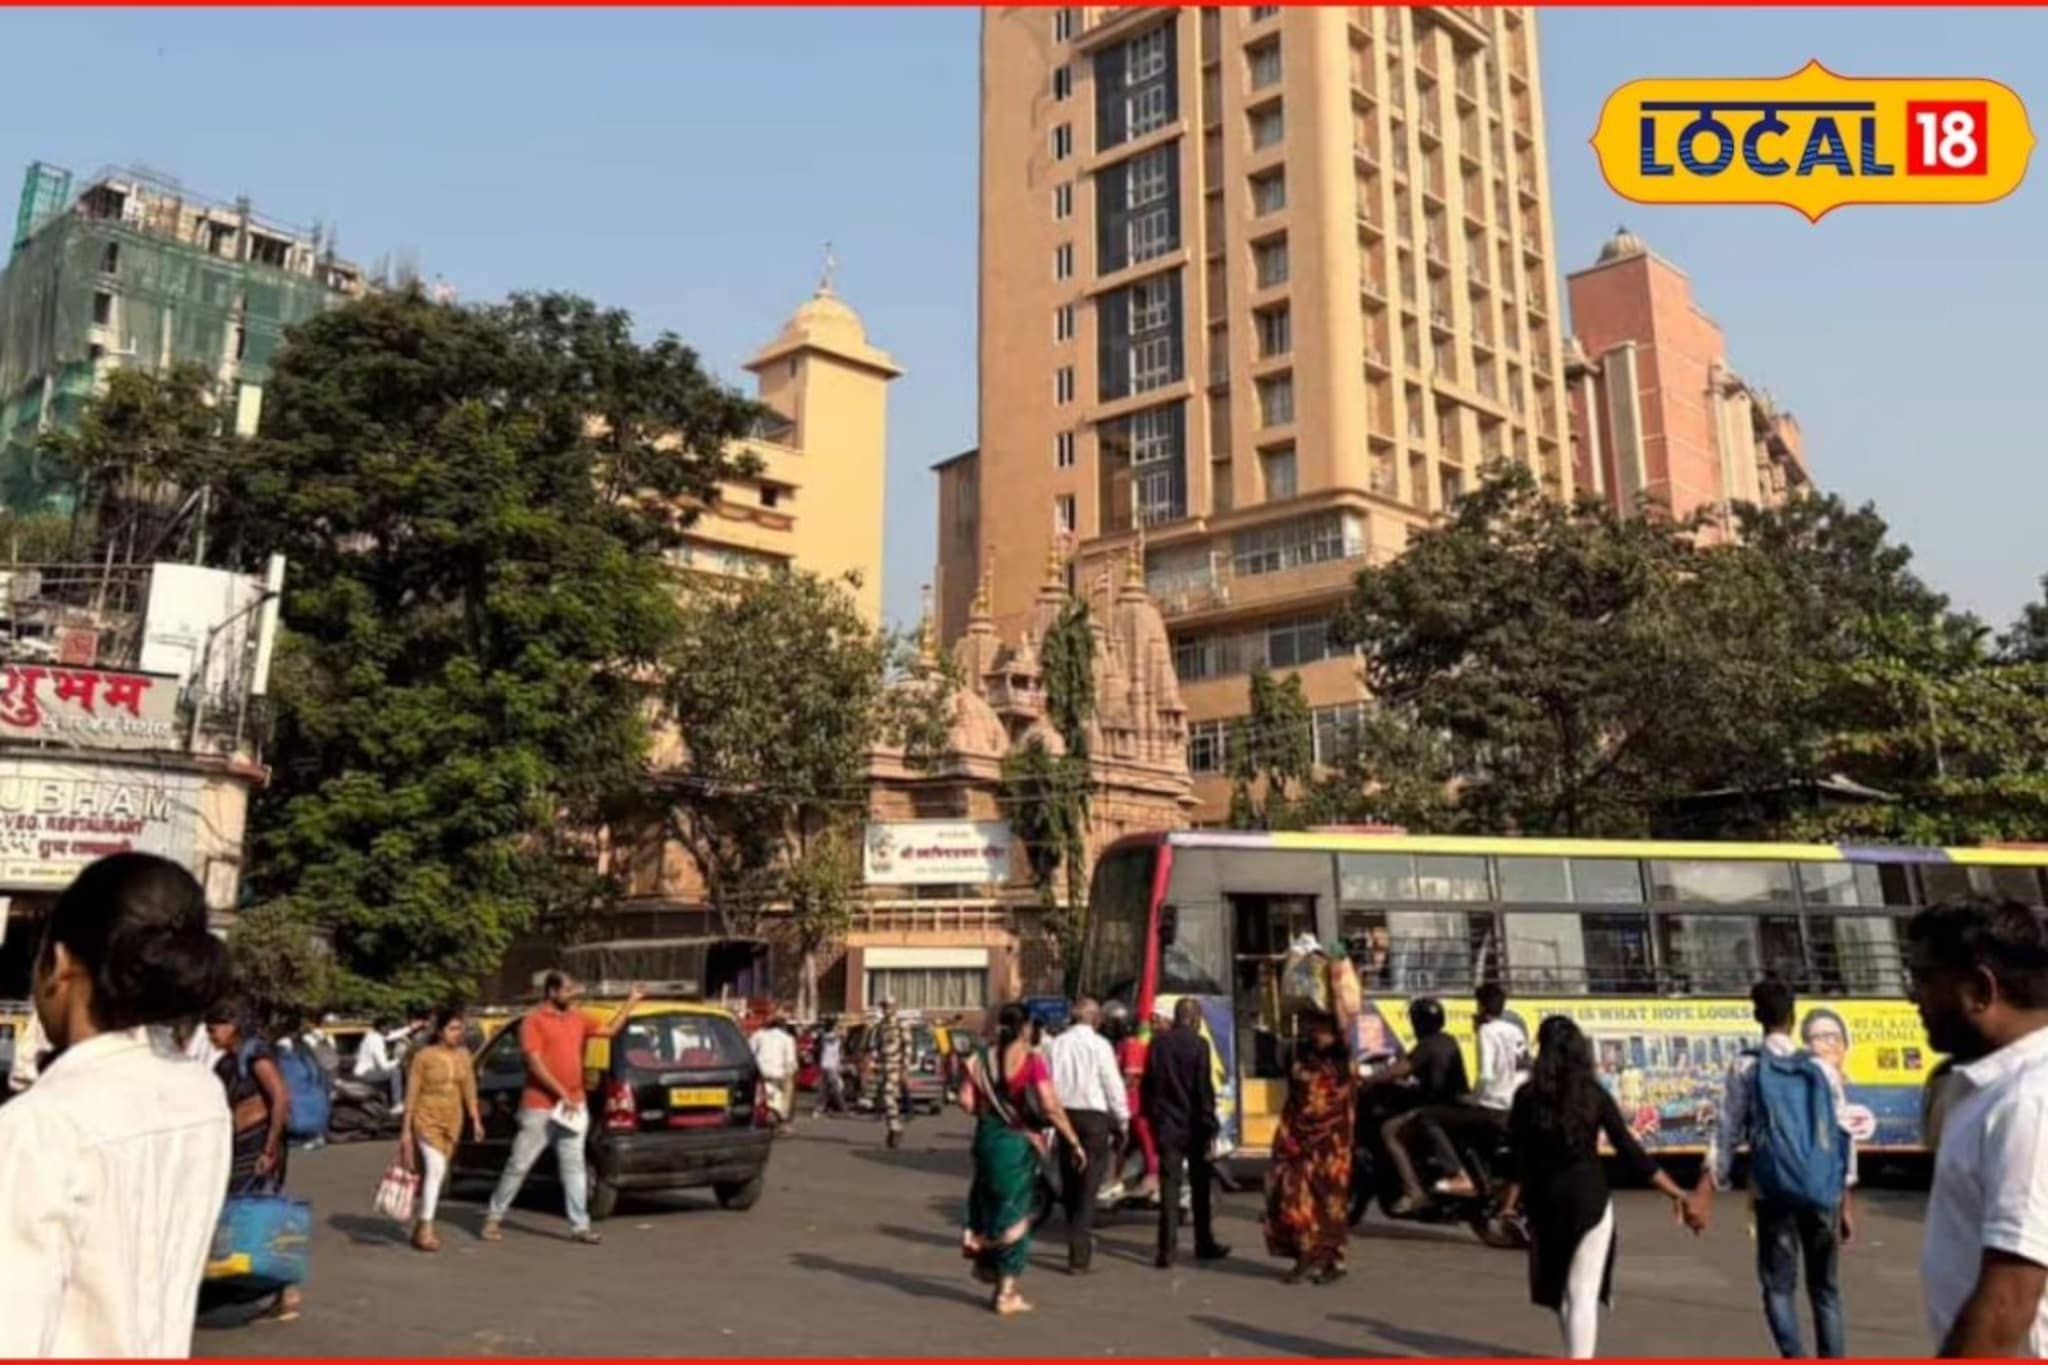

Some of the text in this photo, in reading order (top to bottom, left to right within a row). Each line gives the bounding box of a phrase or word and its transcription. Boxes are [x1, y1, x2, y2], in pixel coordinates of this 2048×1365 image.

[45, 815, 143, 836] RESTAURANT
[1599, 1007, 1648, 1020] WHAT
[1652, 1007, 1694, 1020] HOPE
[1698, 1007, 1750, 1020] LOOKS
